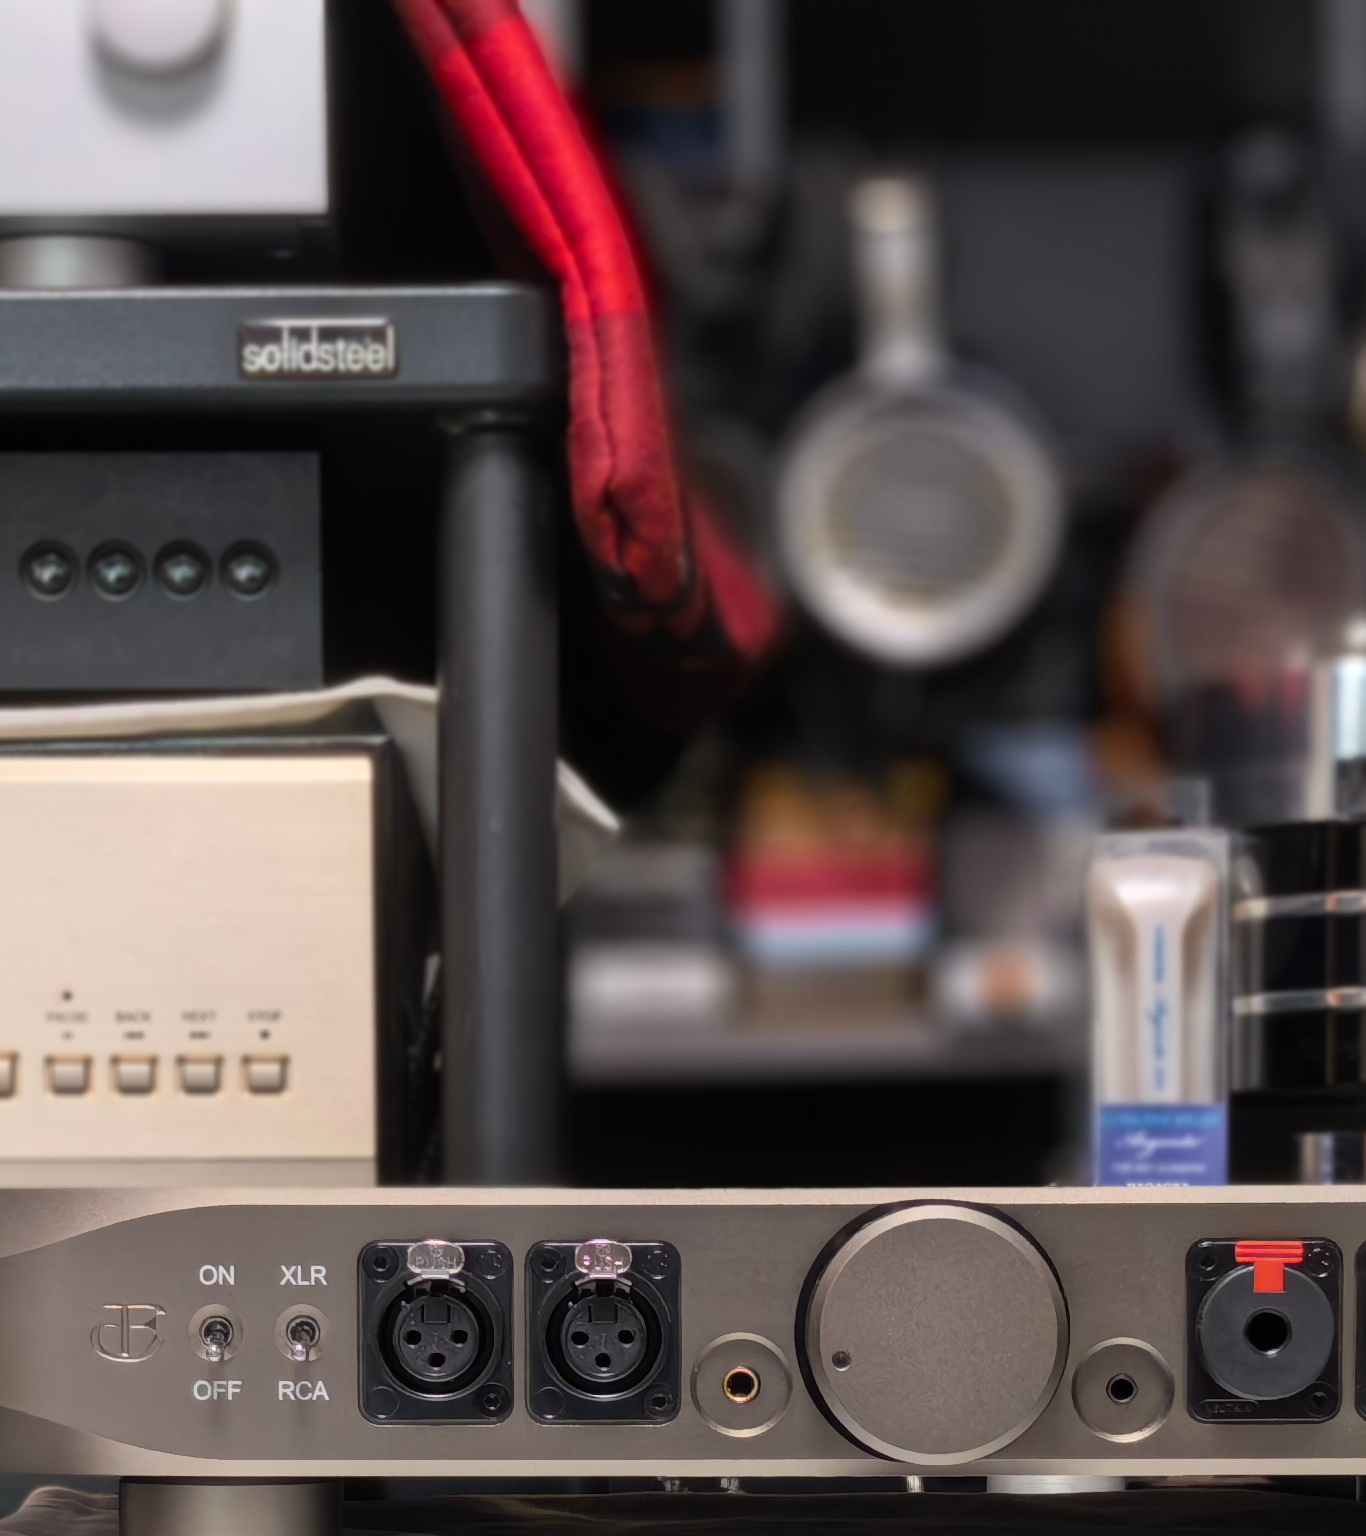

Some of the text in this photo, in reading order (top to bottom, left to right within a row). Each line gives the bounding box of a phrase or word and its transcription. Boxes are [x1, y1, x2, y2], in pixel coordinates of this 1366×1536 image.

[242, 320, 395, 372] solidsteel
[45, 1011, 88, 1024] PAUSE
[114, 1011, 152, 1023] BACK
[181, 1009, 217, 1023] NEXT
[246, 1009, 283, 1023] STOP
[199, 1264, 235, 1286] ON
[279, 1264, 328, 1286] XLR
[192, 1379, 243, 1401] OFF
[278, 1380, 330, 1401] RCA
